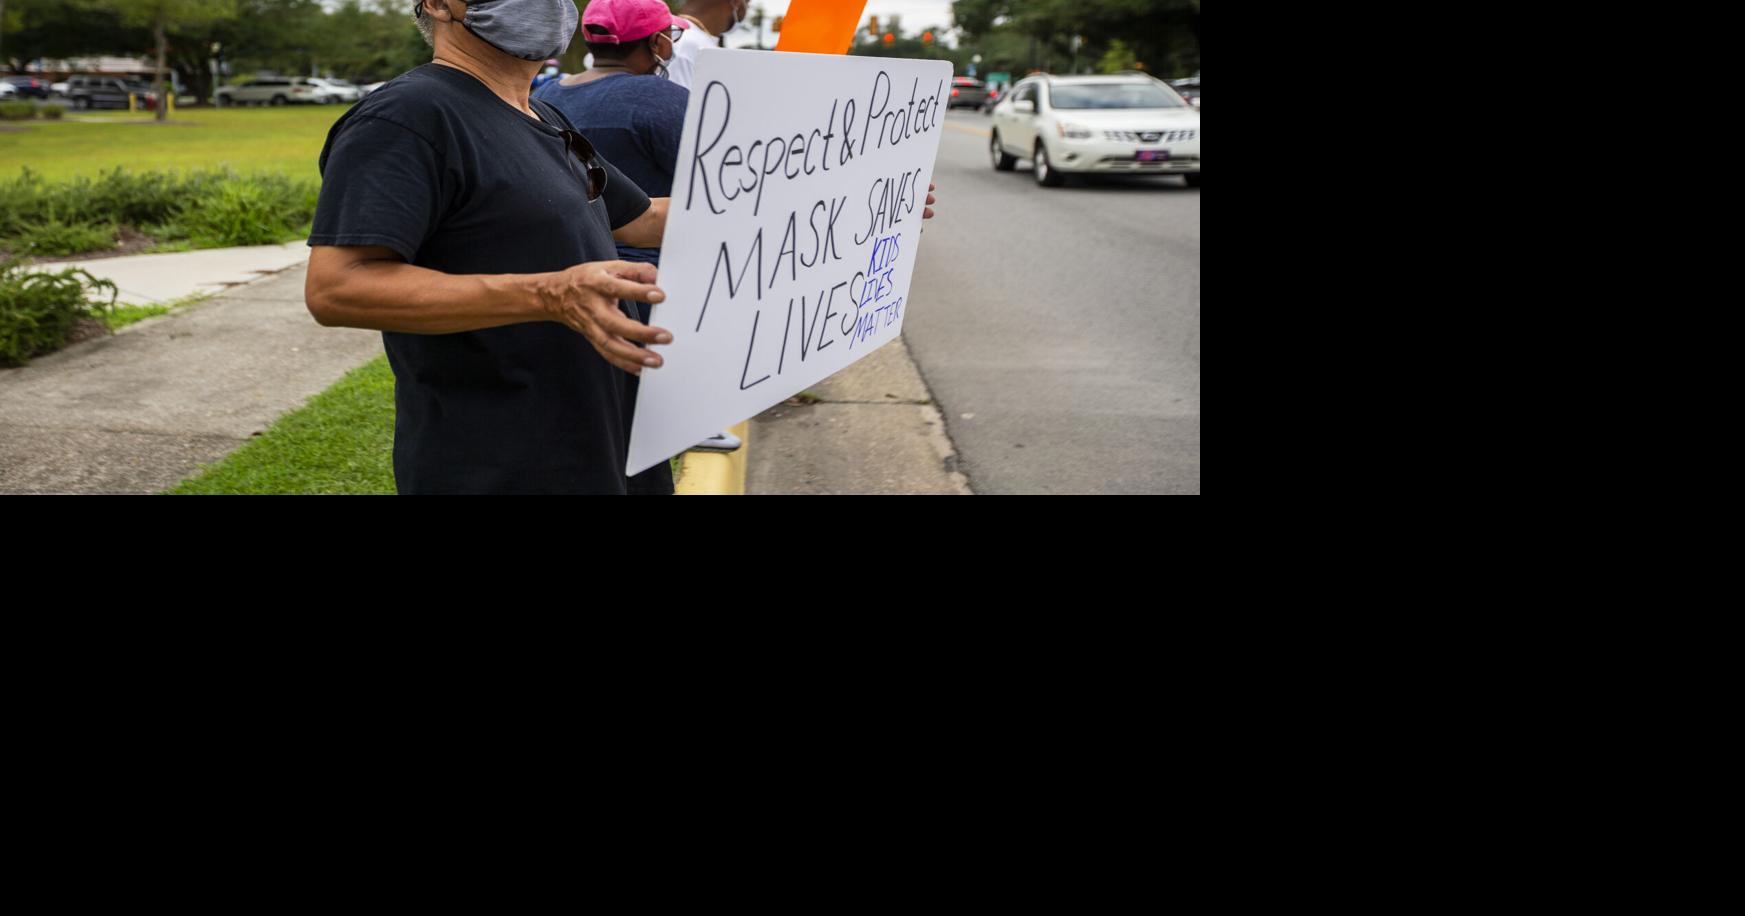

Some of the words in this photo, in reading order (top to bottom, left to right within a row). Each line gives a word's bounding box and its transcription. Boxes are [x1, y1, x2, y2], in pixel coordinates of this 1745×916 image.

[686, 80, 837, 216] Respect
[840, 98, 855, 166] &
[860, 70, 943, 156] Protect
[695, 196, 847, 332] MASK
[855, 168, 921, 245] SAVES
[859, 268, 894, 308] LIVES
[867, 233, 901, 277] KIDS
[740, 271, 864, 390] LIVES
[849, 297, 902, 350] MATTER
